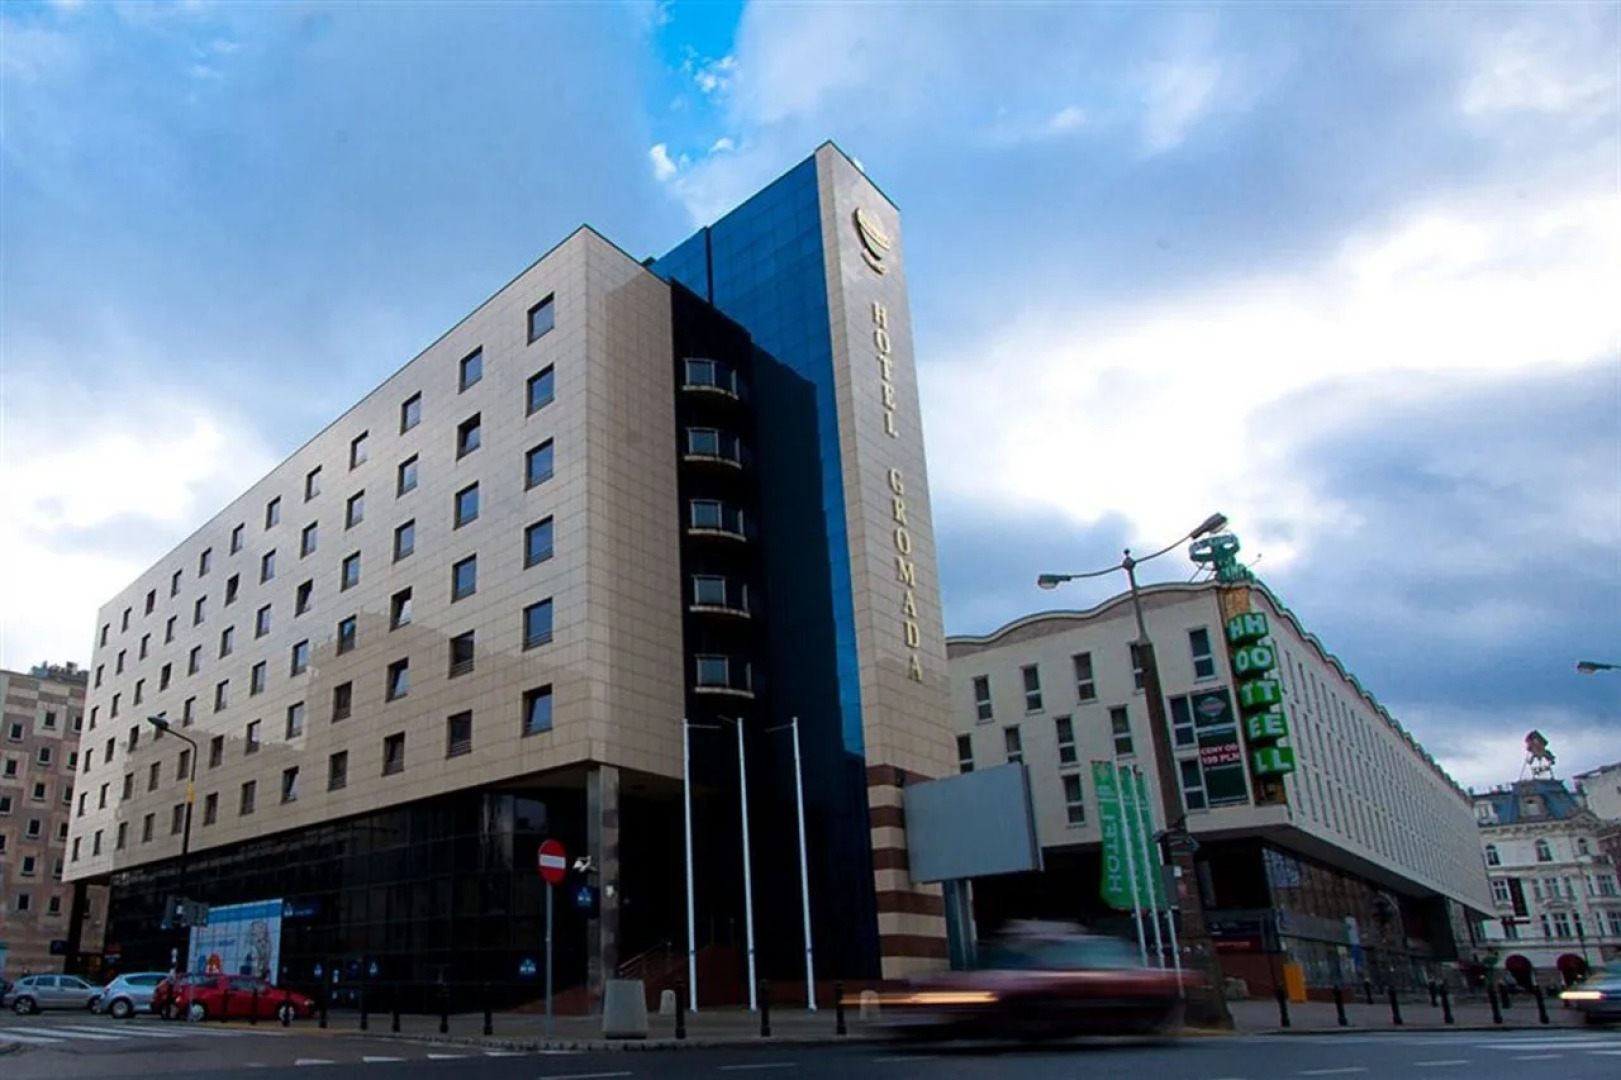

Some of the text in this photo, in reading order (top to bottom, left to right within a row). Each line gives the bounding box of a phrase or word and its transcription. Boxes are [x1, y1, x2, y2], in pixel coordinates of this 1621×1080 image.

[871, 301, 922, 683] HOTEL GROMADA
[1244, 612, 1292, 771] HOTEL
